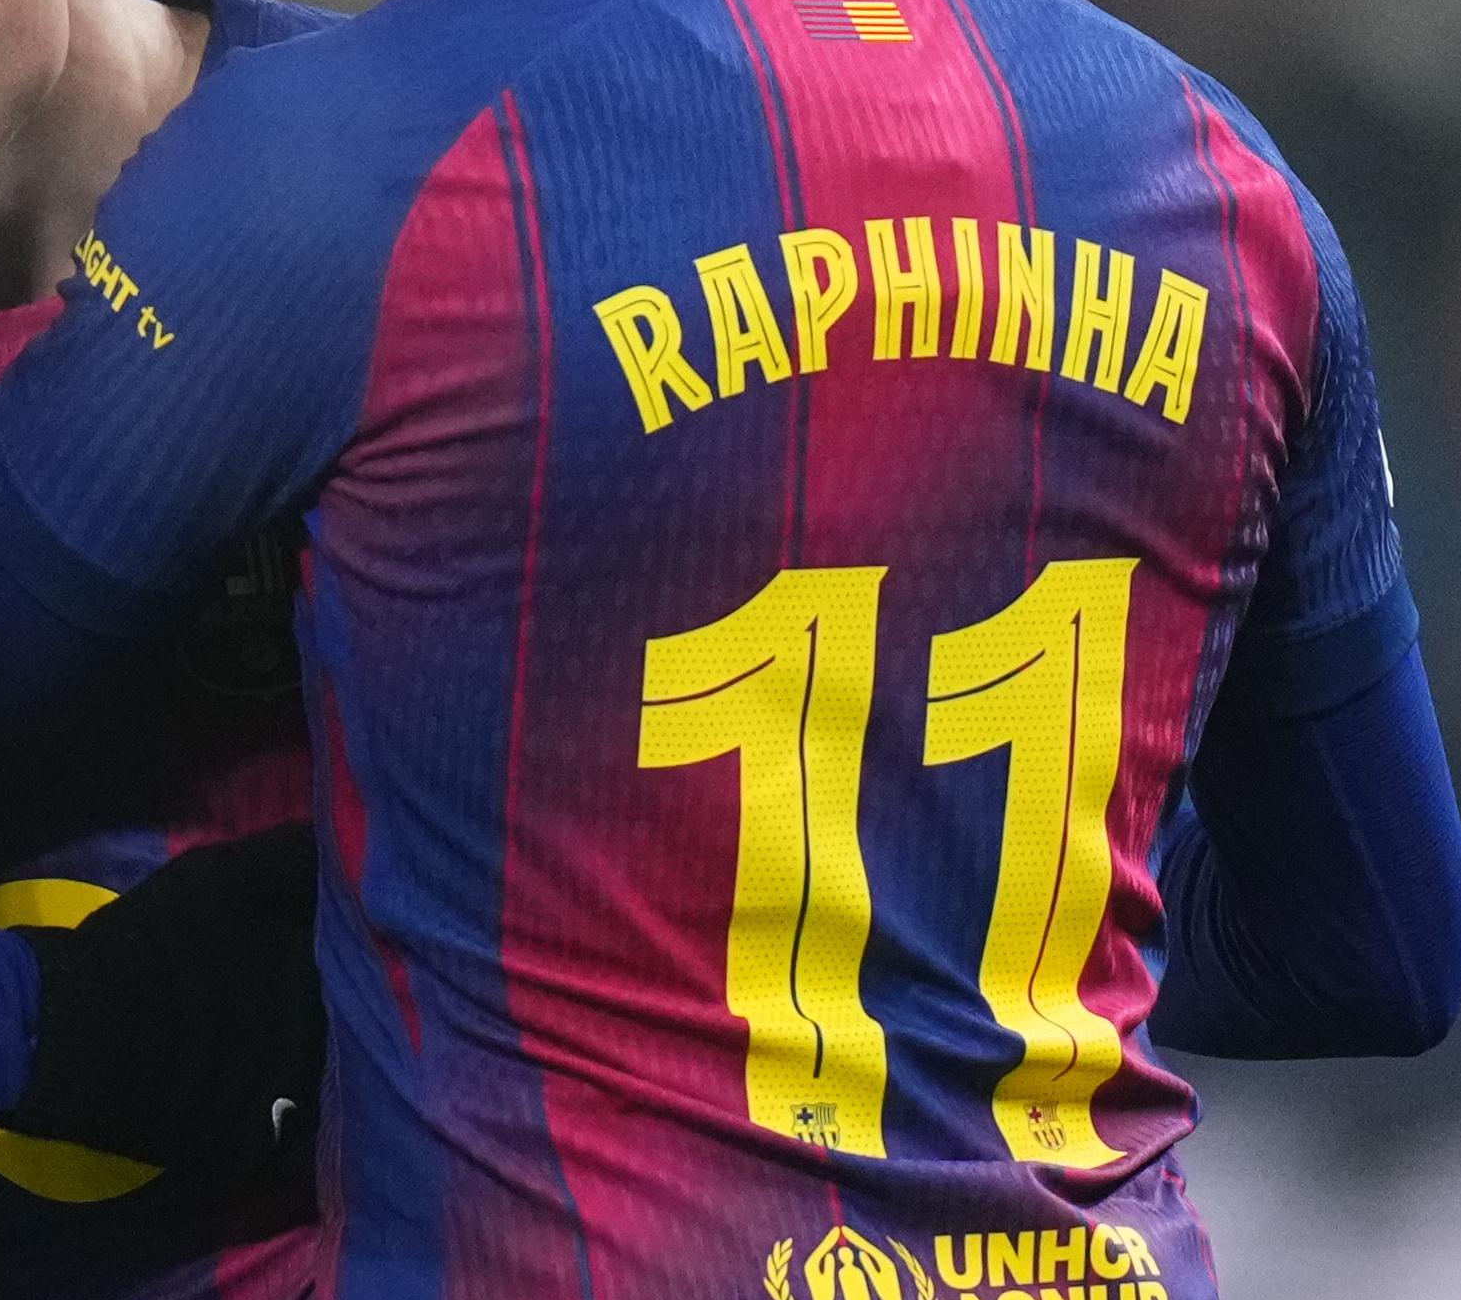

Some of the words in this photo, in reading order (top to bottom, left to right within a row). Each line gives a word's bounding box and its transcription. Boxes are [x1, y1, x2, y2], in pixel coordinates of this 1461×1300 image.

[593, 217, 1209, 434] RAPHINHA
[638, 557, 1141, 1168] 11
[934, 1223, 1160, 1289] UNHCR
